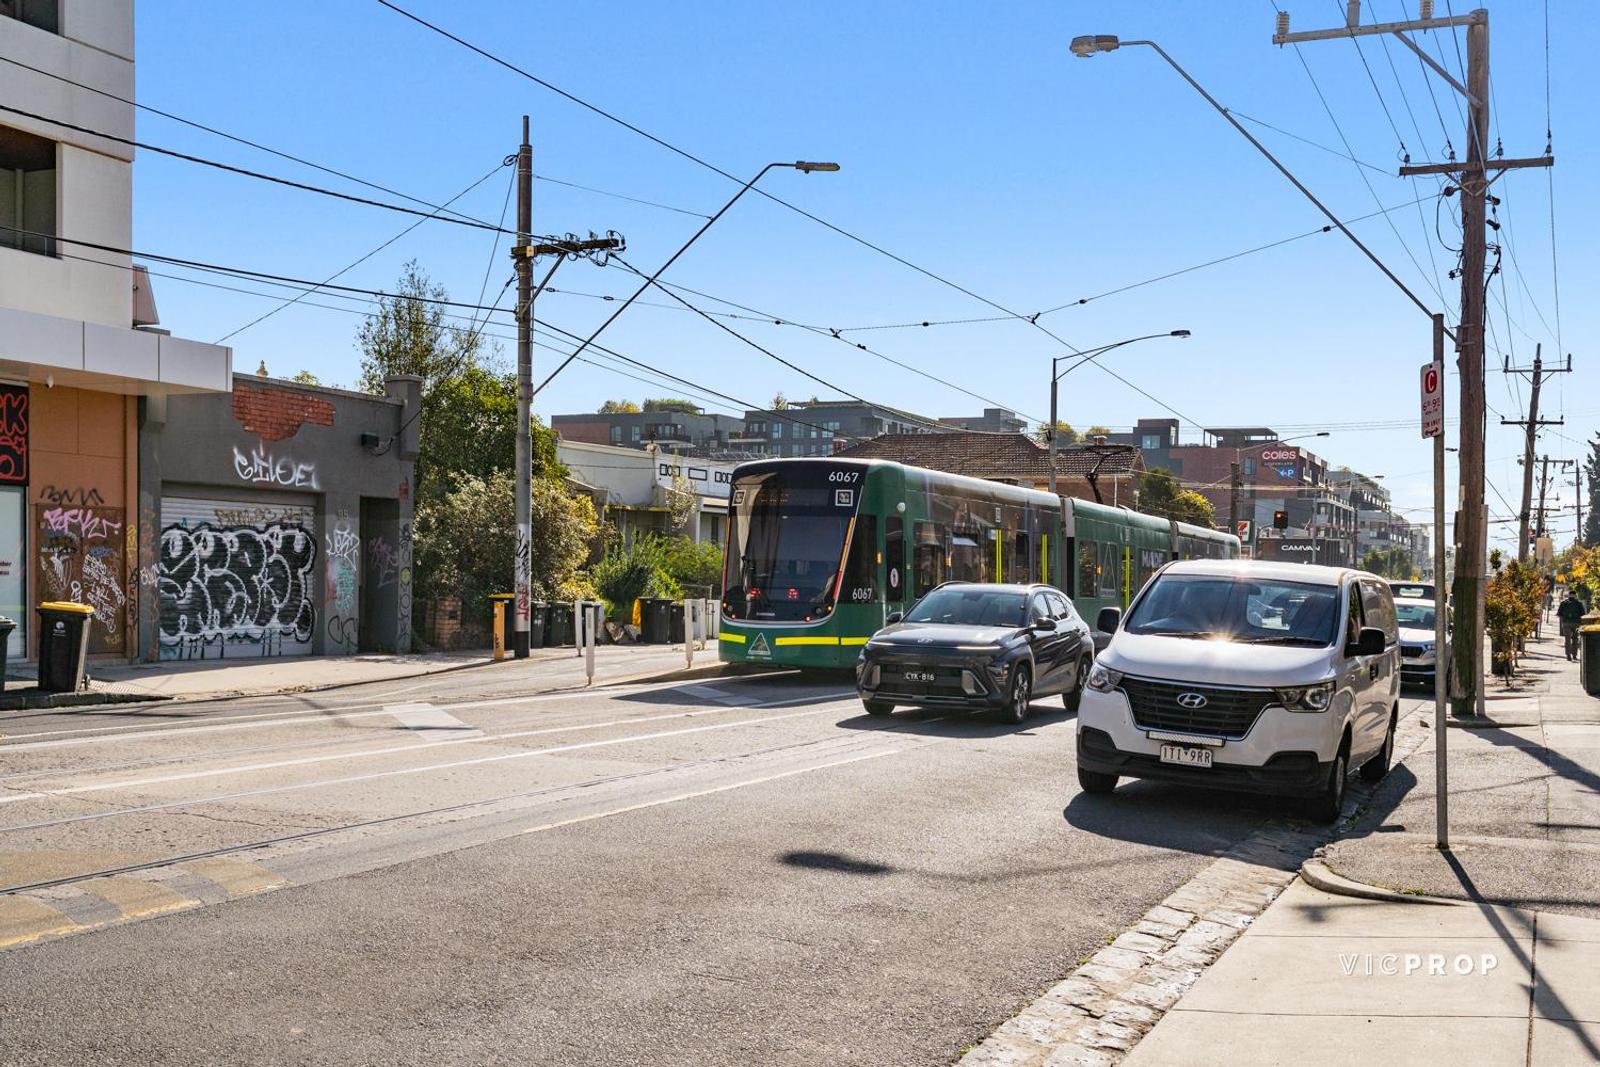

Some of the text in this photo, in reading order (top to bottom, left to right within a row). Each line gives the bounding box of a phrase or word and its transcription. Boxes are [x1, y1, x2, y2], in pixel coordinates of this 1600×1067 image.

[1262, 450, 1296, 460] coles
[828, 471, 859, 483] 6067
[852, 587, 872, 600] 6067
